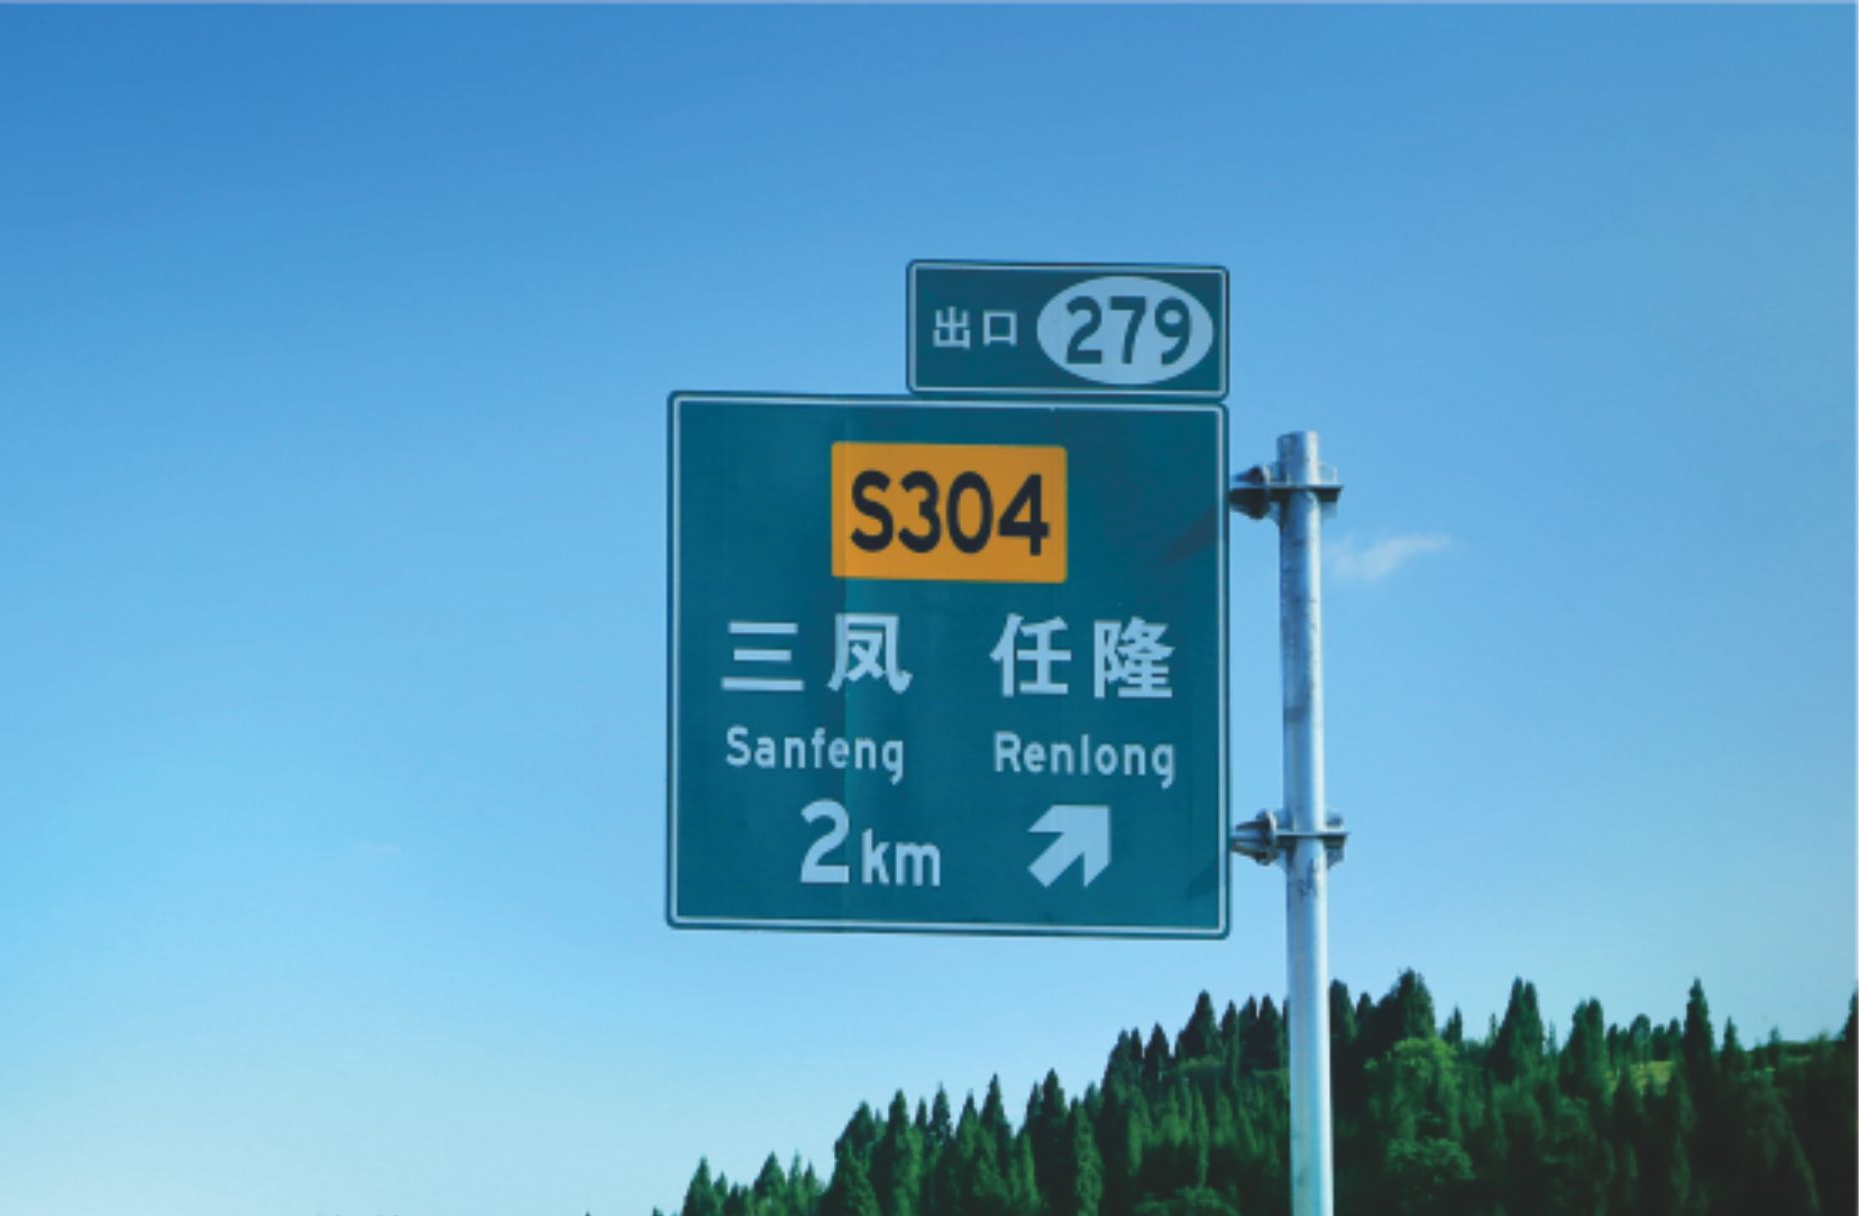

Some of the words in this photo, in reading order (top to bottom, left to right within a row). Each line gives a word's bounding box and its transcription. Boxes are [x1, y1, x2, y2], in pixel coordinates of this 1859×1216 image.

[933, 307, 1017, 348] 出口
[1065, 296, 1192, 365] 279
[851, 470, 1049, 556] S304
[722, 613, 912, 693] 三凤
[990, 613, 1174, 698] 任隆
[726, 725, 903, 784] Sanfeng
[995, 731, 1175, 788] Renlong
